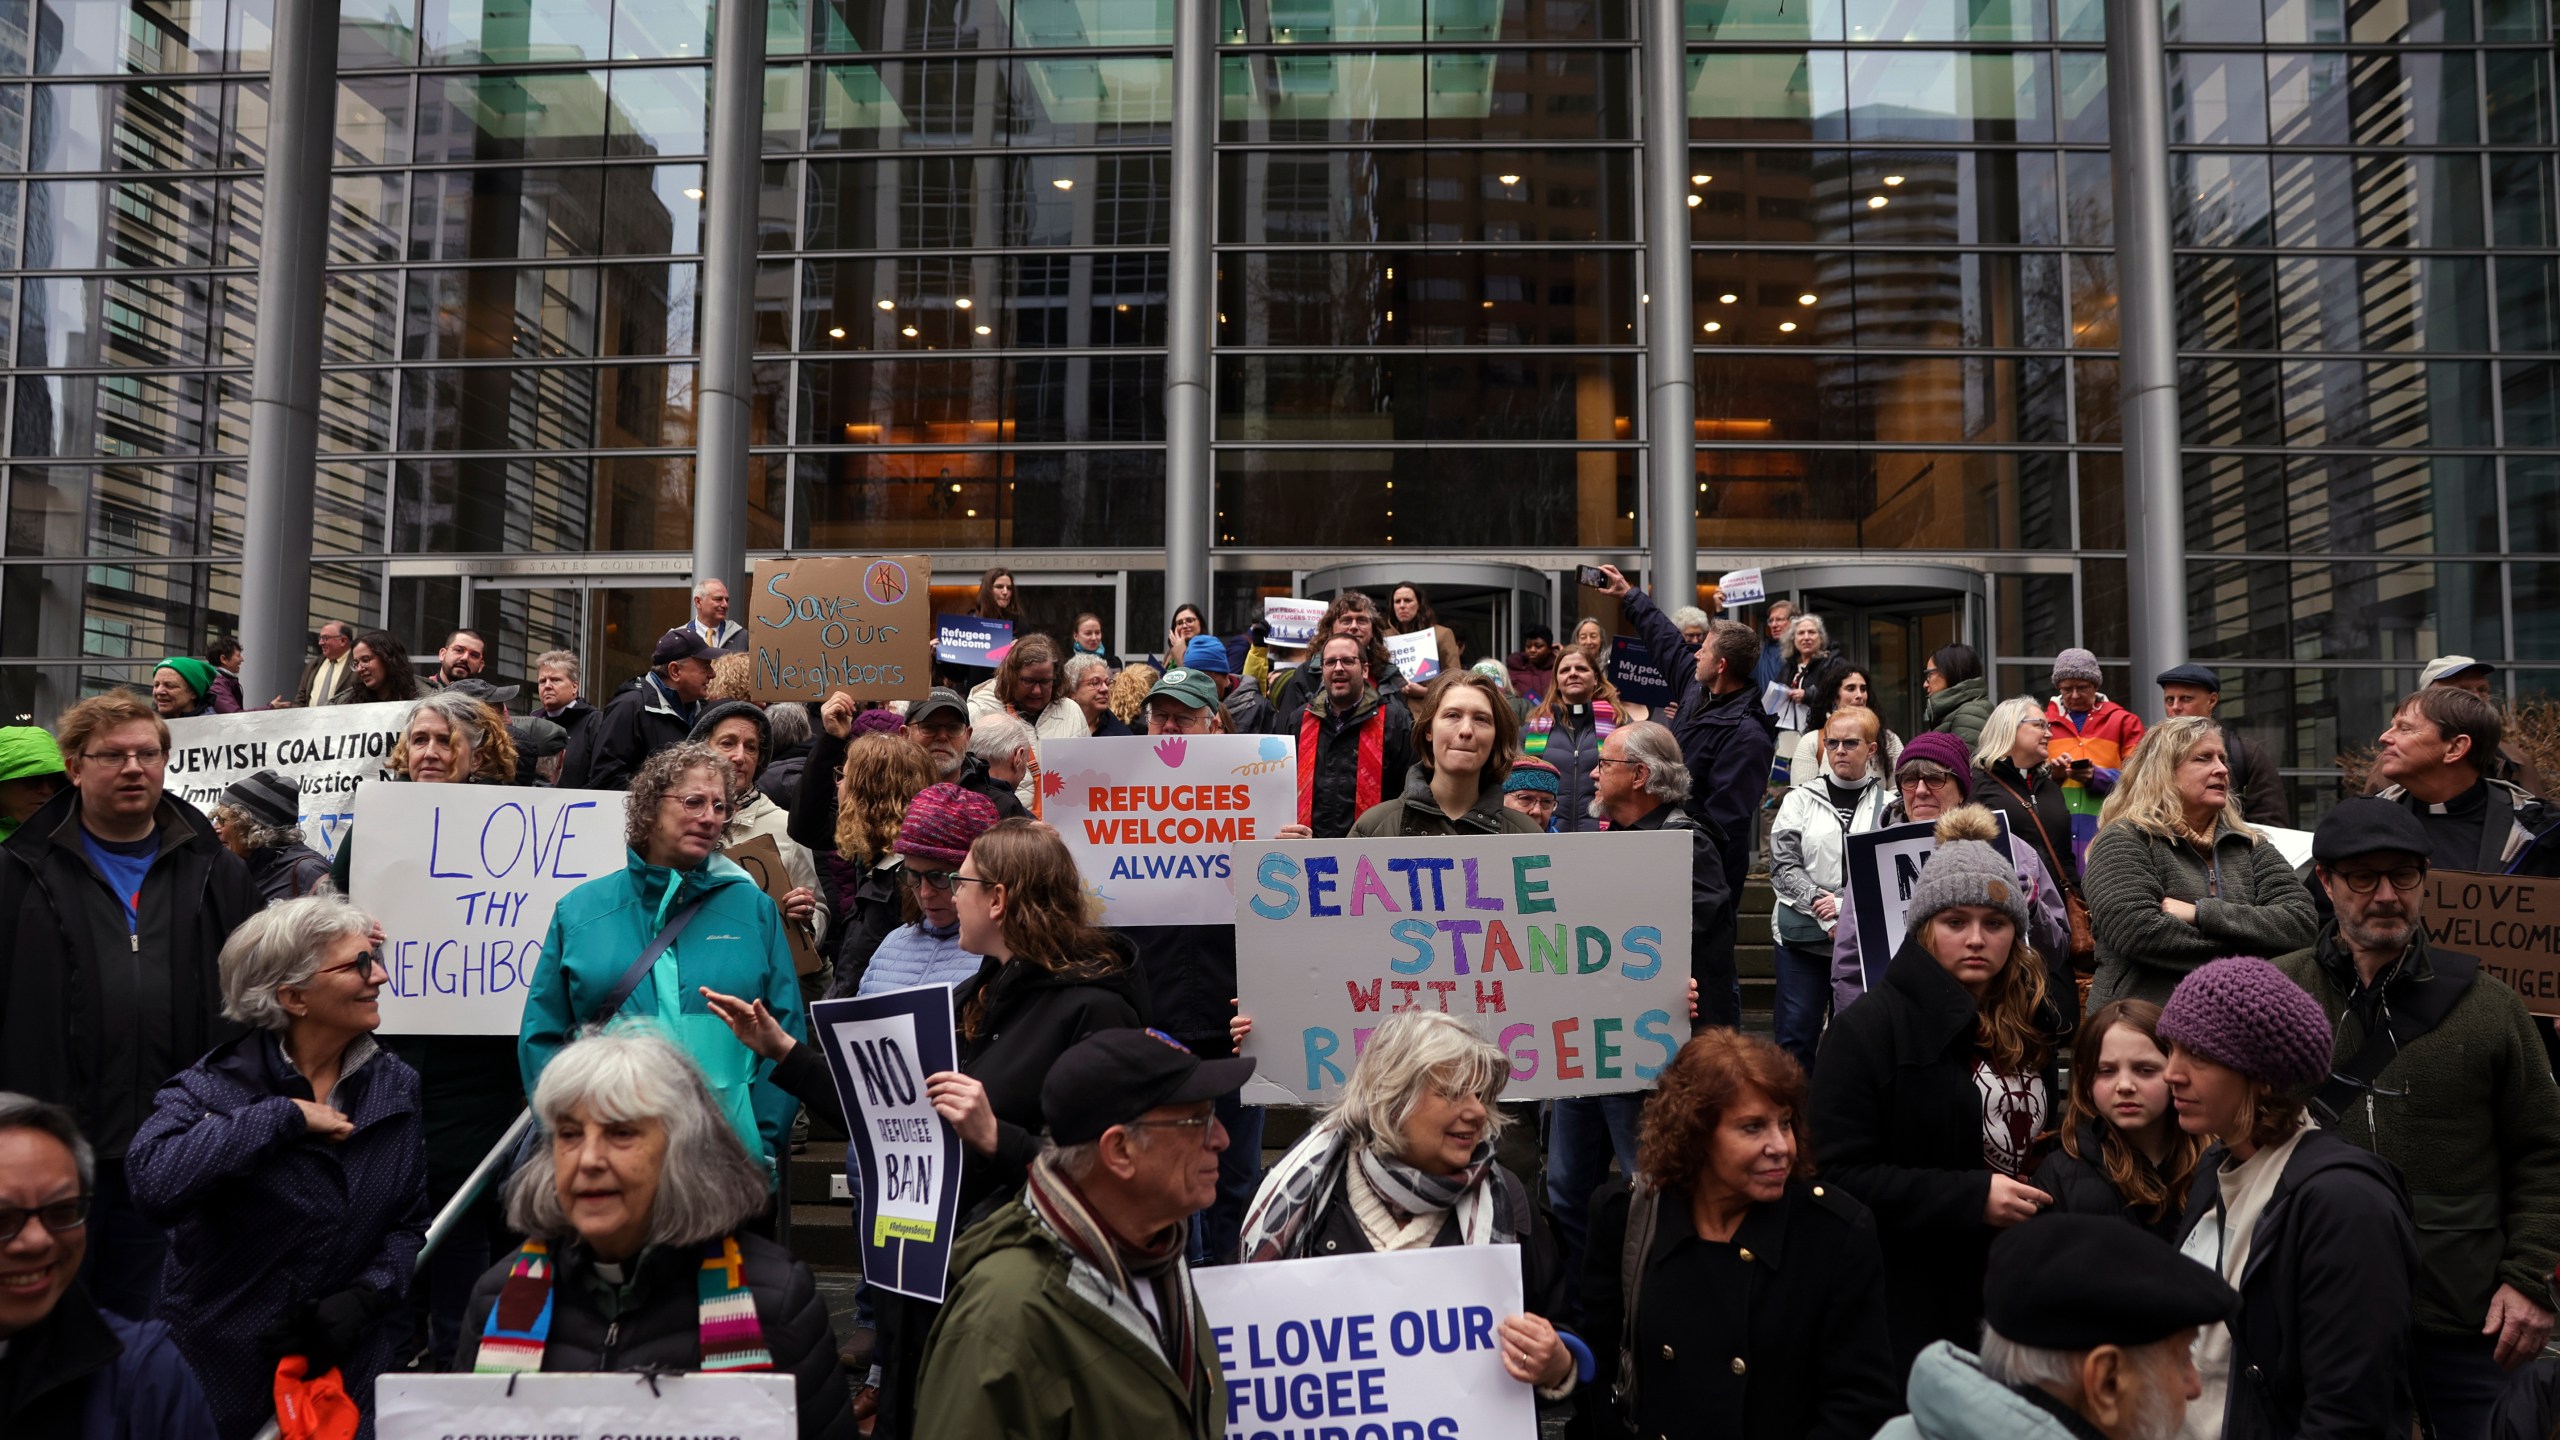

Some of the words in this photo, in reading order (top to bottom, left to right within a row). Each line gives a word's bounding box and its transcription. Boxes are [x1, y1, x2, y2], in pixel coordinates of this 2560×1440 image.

[455, 562, 518, 571] UNITED
[529, 561, 589, 571] STATES
[600, 560, 692, 571] COURTHOU
[757, 573, 864, 628] Save
[940, 636, 991, 649] Welcome
[941, 627, 992, 641] Refugees
[1390, 645, 1416, 659] gees
[757, 647, 905, 697] Neighbors
[1617, 671, 1668, 687] refugees
[1619, 660, 1637, 673] My
[1638, 665, 1662, 677] peo
[168, 741, 268, 775] JEWISH
[276, 730, 402, 766] COALITION
[1088, 784, 1251, 812] REFUGEES
[430, 801, 597, 879] LOVE
[1083, 817, 1256, 845] WELCOME
[1109, 853, 1231, 880] ALWAYS
[1895, 851, 1932, 901] N
[1249, 851, 1557, 921] SEATTLE
[2437, 880, 2536, 913] LOVE
[456, 890, 529, 928] THY
[383, 938, 543, 998] NEIGHBO
[1389, 919, 1662, 981] STANDS
[1345, 977, 1507, 1014] WITH
[1302, 1008, 1680, 1091] RGEES
[850, 1036, 917, 1108] NO
[877, 1117, 933, 1143] REFUGEE
[885, 1152, 933, 1206] BAN
[889, 1221, 932, 1239] #RefugeesBelong
[1247, 1314, 1378, 1370] LOVE
[1389, 1305, 1496, 1357] OUR
[1224, 1367, 1389, 1426] FUGEE
